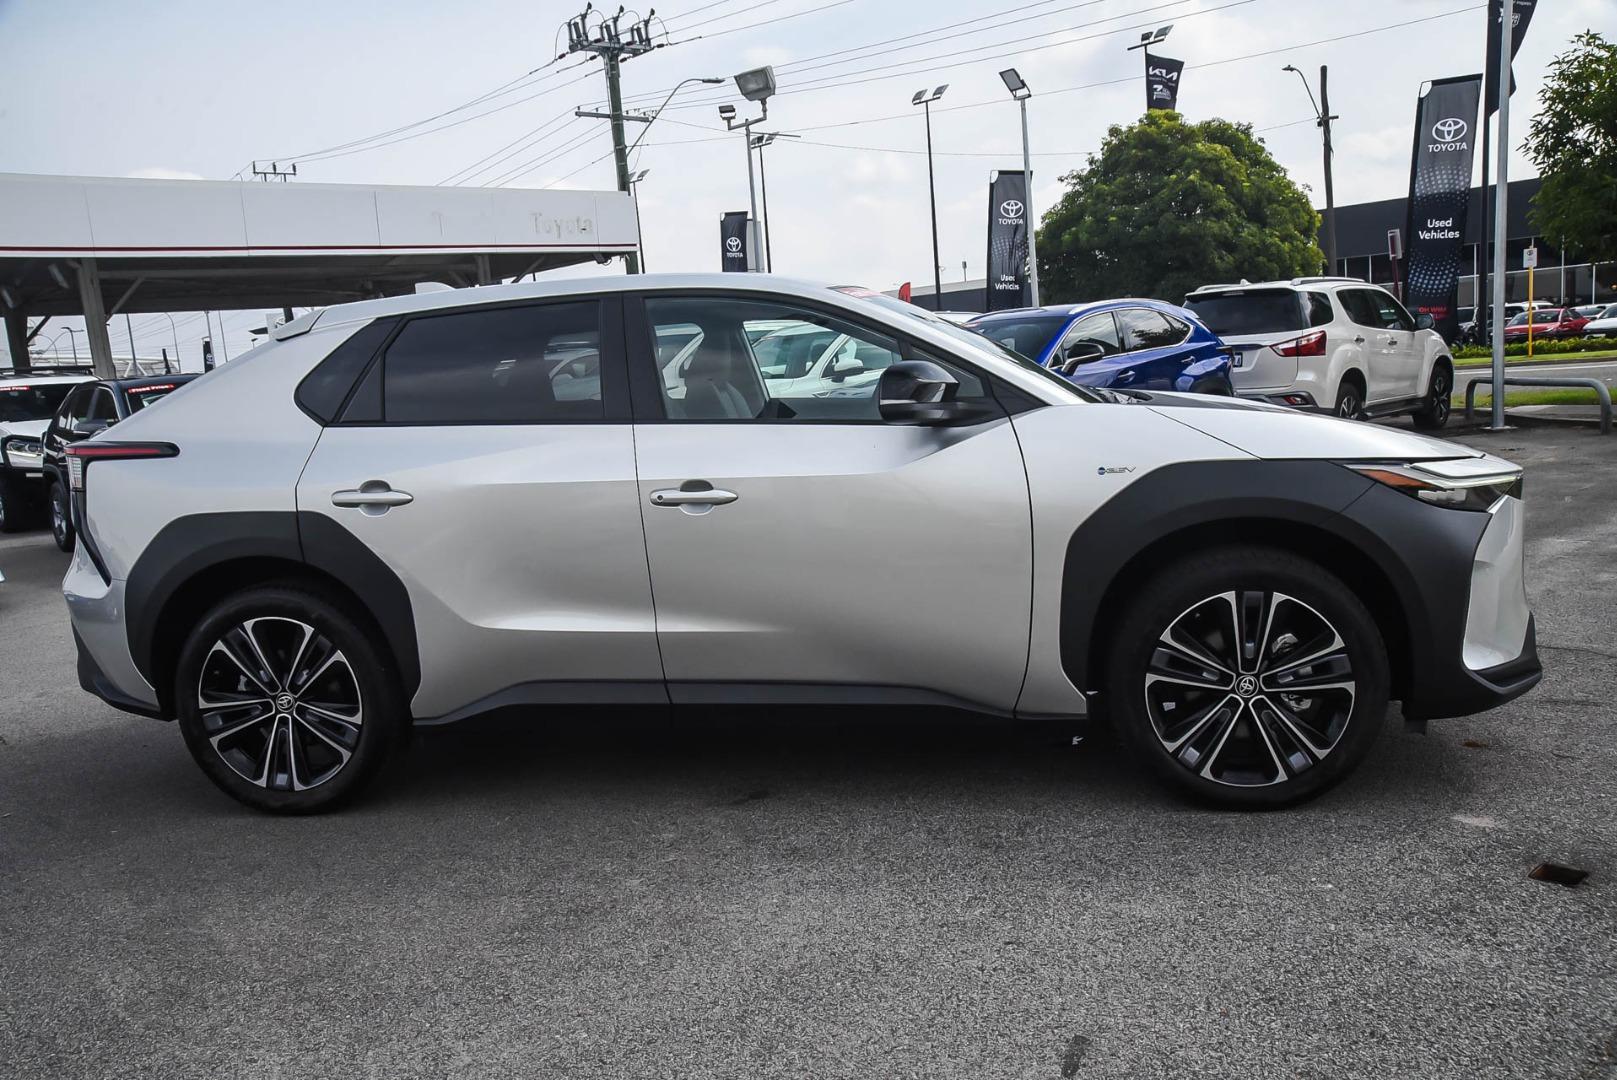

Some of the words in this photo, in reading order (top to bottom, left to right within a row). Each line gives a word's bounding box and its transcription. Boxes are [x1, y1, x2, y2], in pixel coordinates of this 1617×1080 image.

[1428, 142, 1467, 153] TOYOTA
[529, 212, 593, 239] Toyota
[1427, 217, 1453, 228] Used
[1418, 229, 1460, 240] Vehicles
